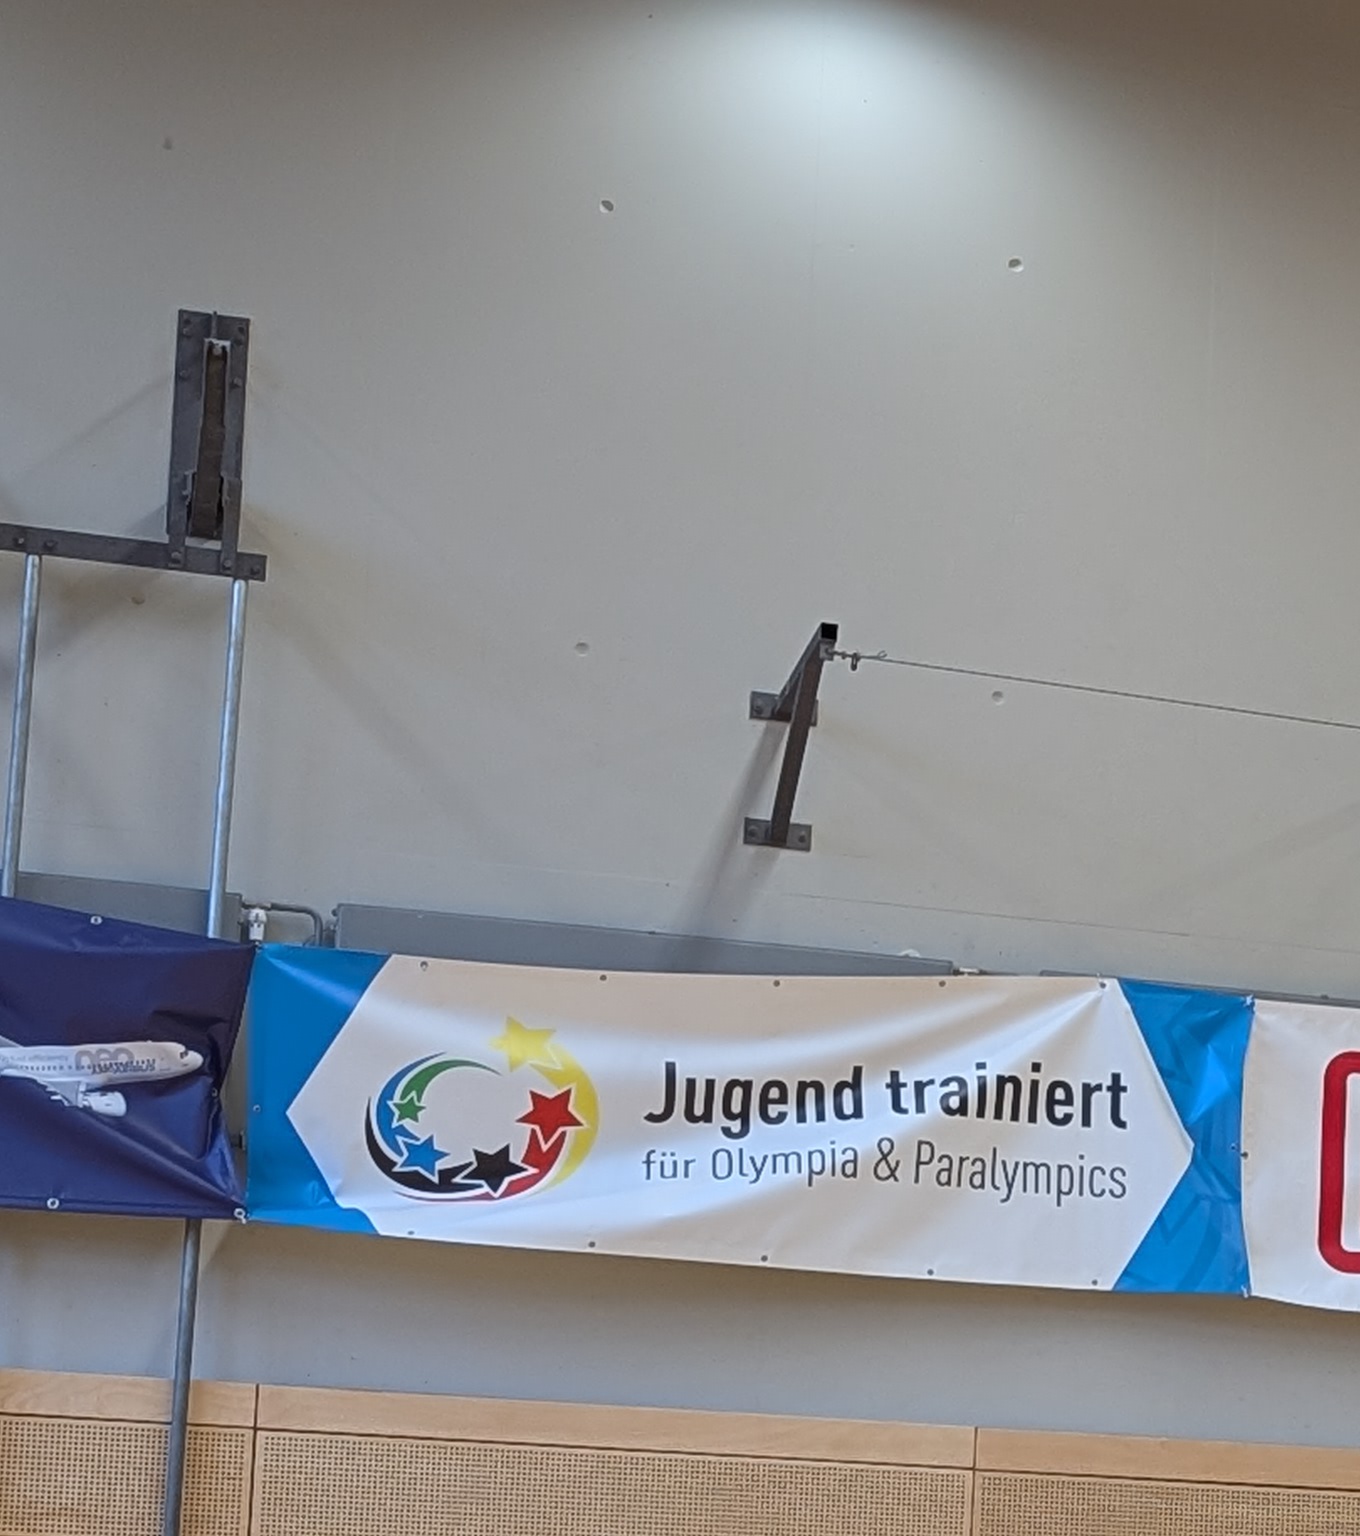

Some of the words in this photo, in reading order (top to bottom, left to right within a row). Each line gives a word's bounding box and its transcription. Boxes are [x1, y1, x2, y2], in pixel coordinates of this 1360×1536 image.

[644, 1062, 864, 1139] Jugend
[886, 1062, 1128, 1131] trainiert
[643, 1150, 697, 1181] für
[712, 1140, 859, 1188] Olympia
[874, 1138, 901, 1183] &
[914, 1140, 1128, 1207] Paralympics
